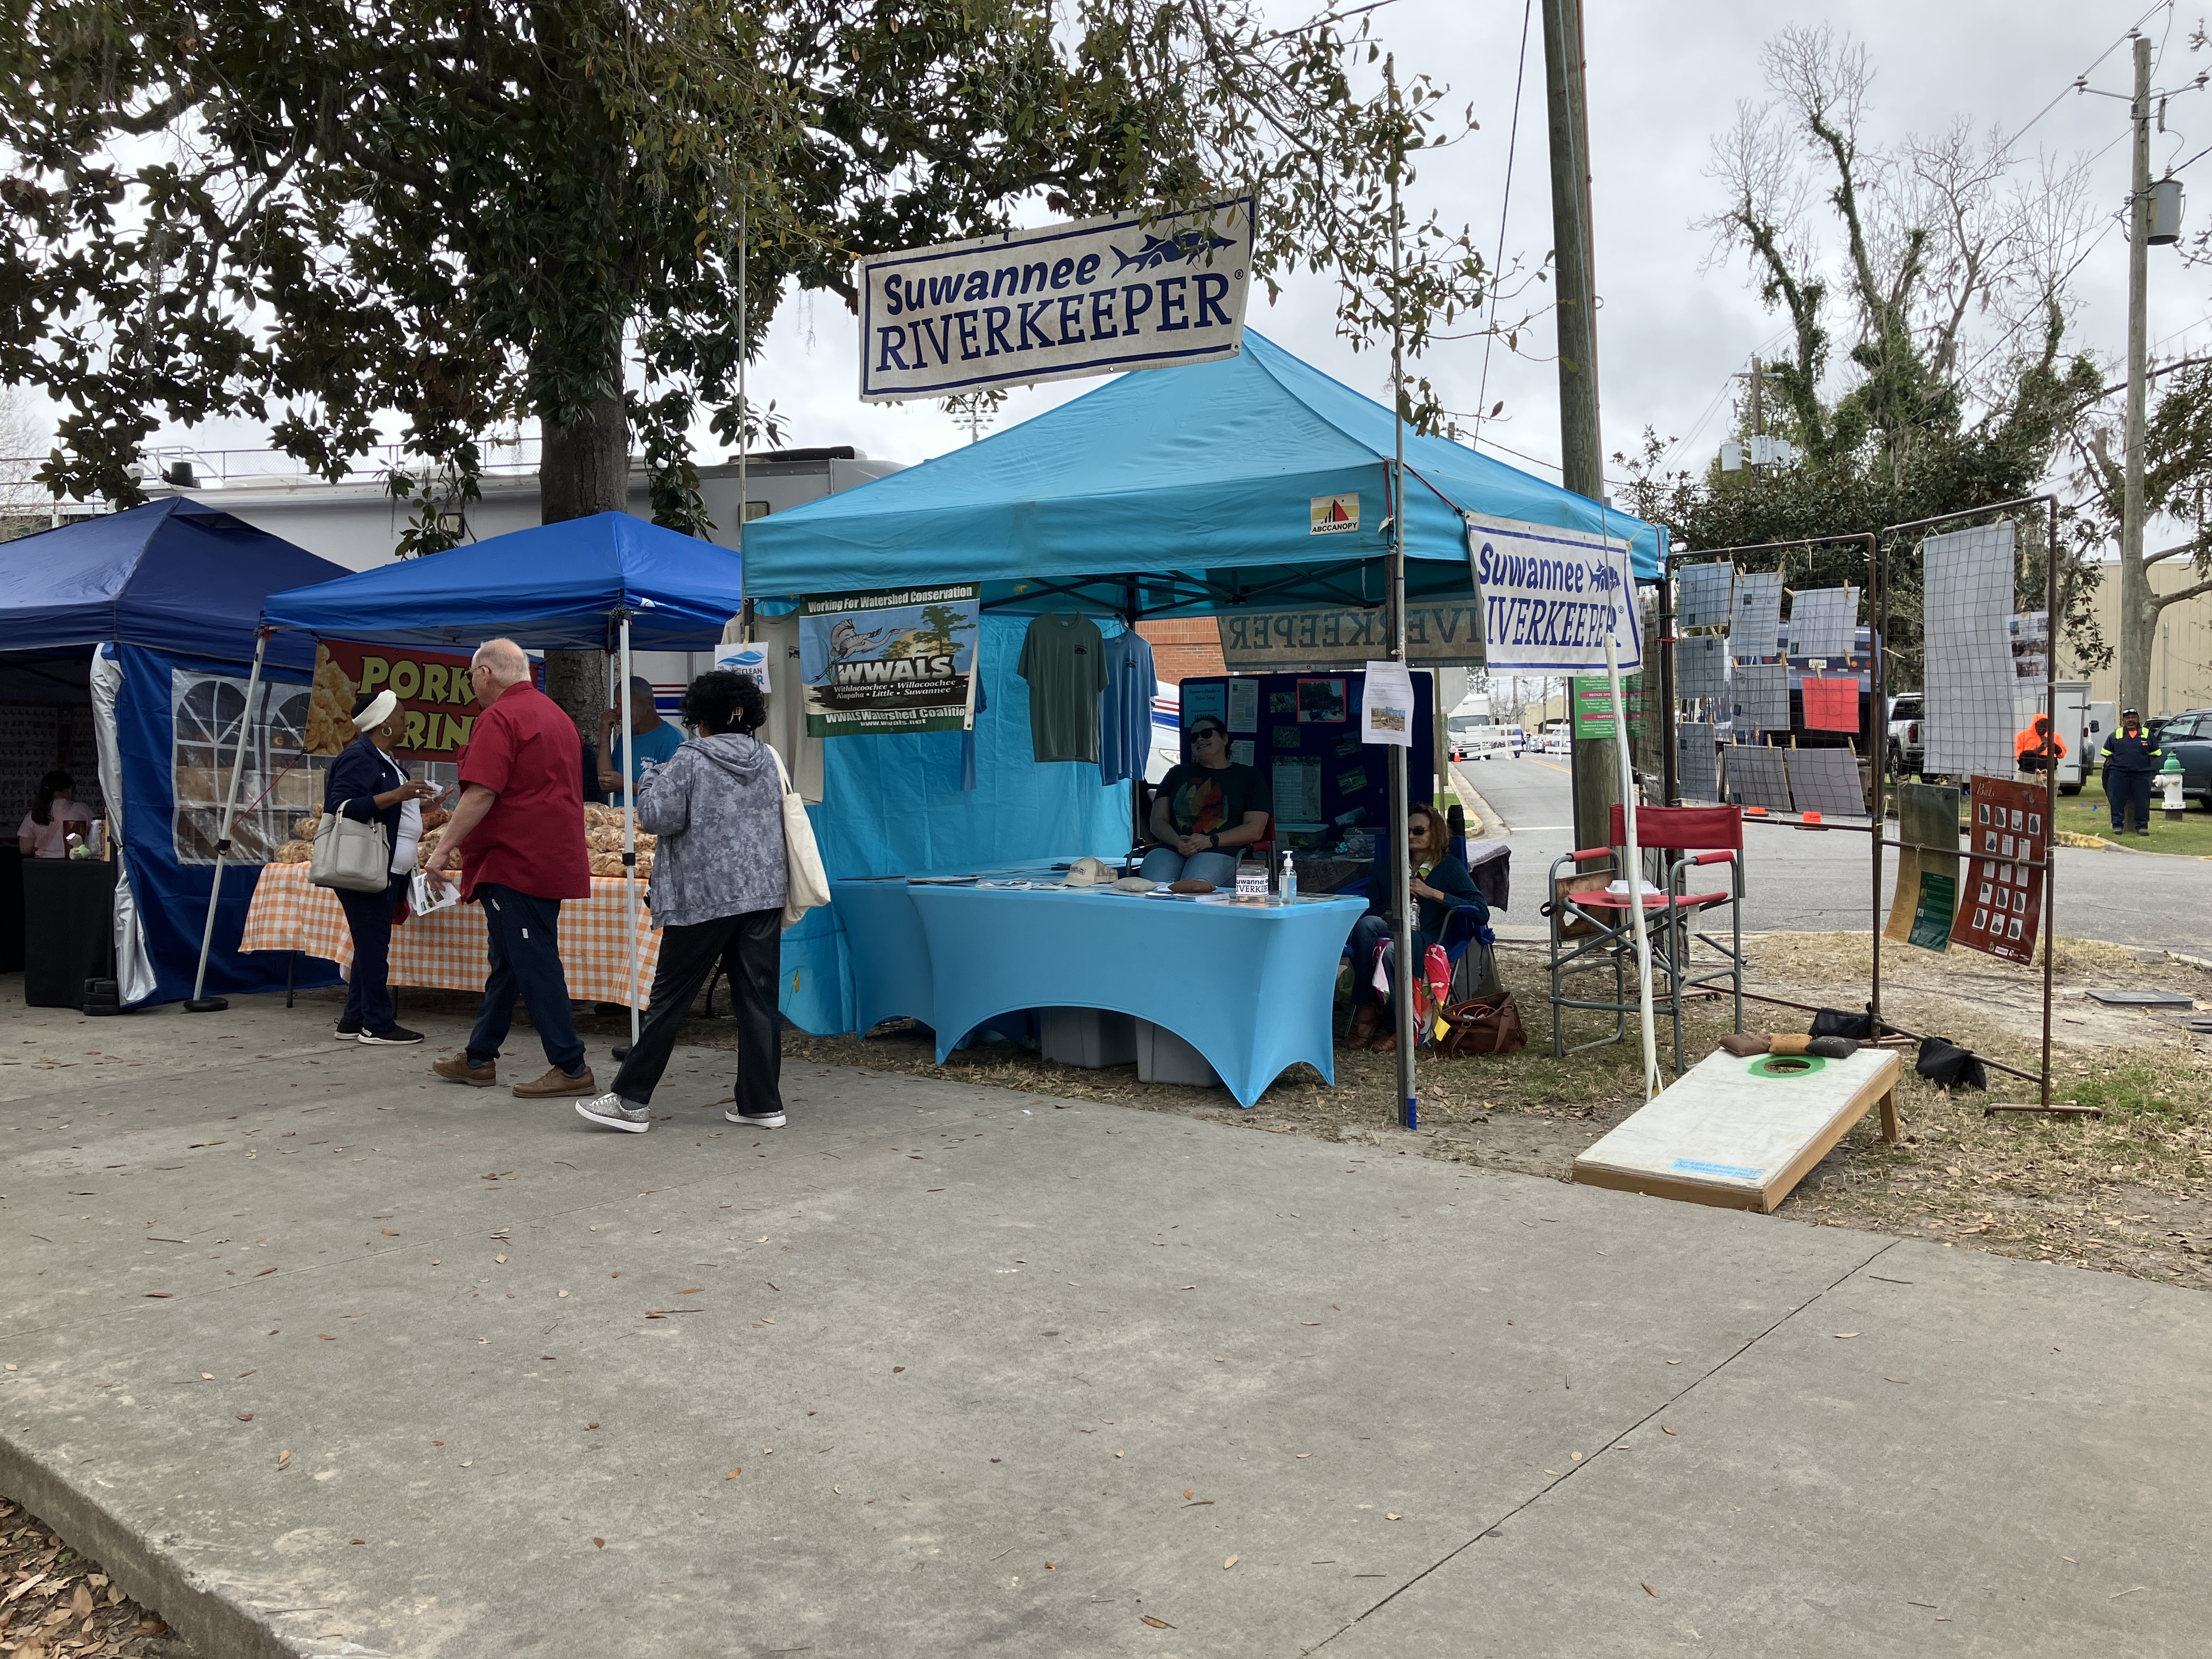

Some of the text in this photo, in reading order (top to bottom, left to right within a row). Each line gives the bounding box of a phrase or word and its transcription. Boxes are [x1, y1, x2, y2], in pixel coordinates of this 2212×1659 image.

[884, 253, 1101, 315] Suwannee
[1312, 522, 1357, 533] ABCCANOPY
[1479, 543, 1583, 593] Suwannee
[808, 586, 973, 613] Working For Watershed Conservation
[358, 656, 477, 706] PORK
[838, 656, 952, 684] WWALS
[834, 680, 956, 693] Withlacoochee Willacoochee
[836, 692, 865, 700] Alapaha
[904, 687, 951, 696] Suwannee
[825, 707, 965, 724] WWALS Watershed Coalitio
[394, 710, 478, 751] RIN
[1977, 783, 1995, 797] Bats
[1689, 1165, 1733, 1175] Suwannee
